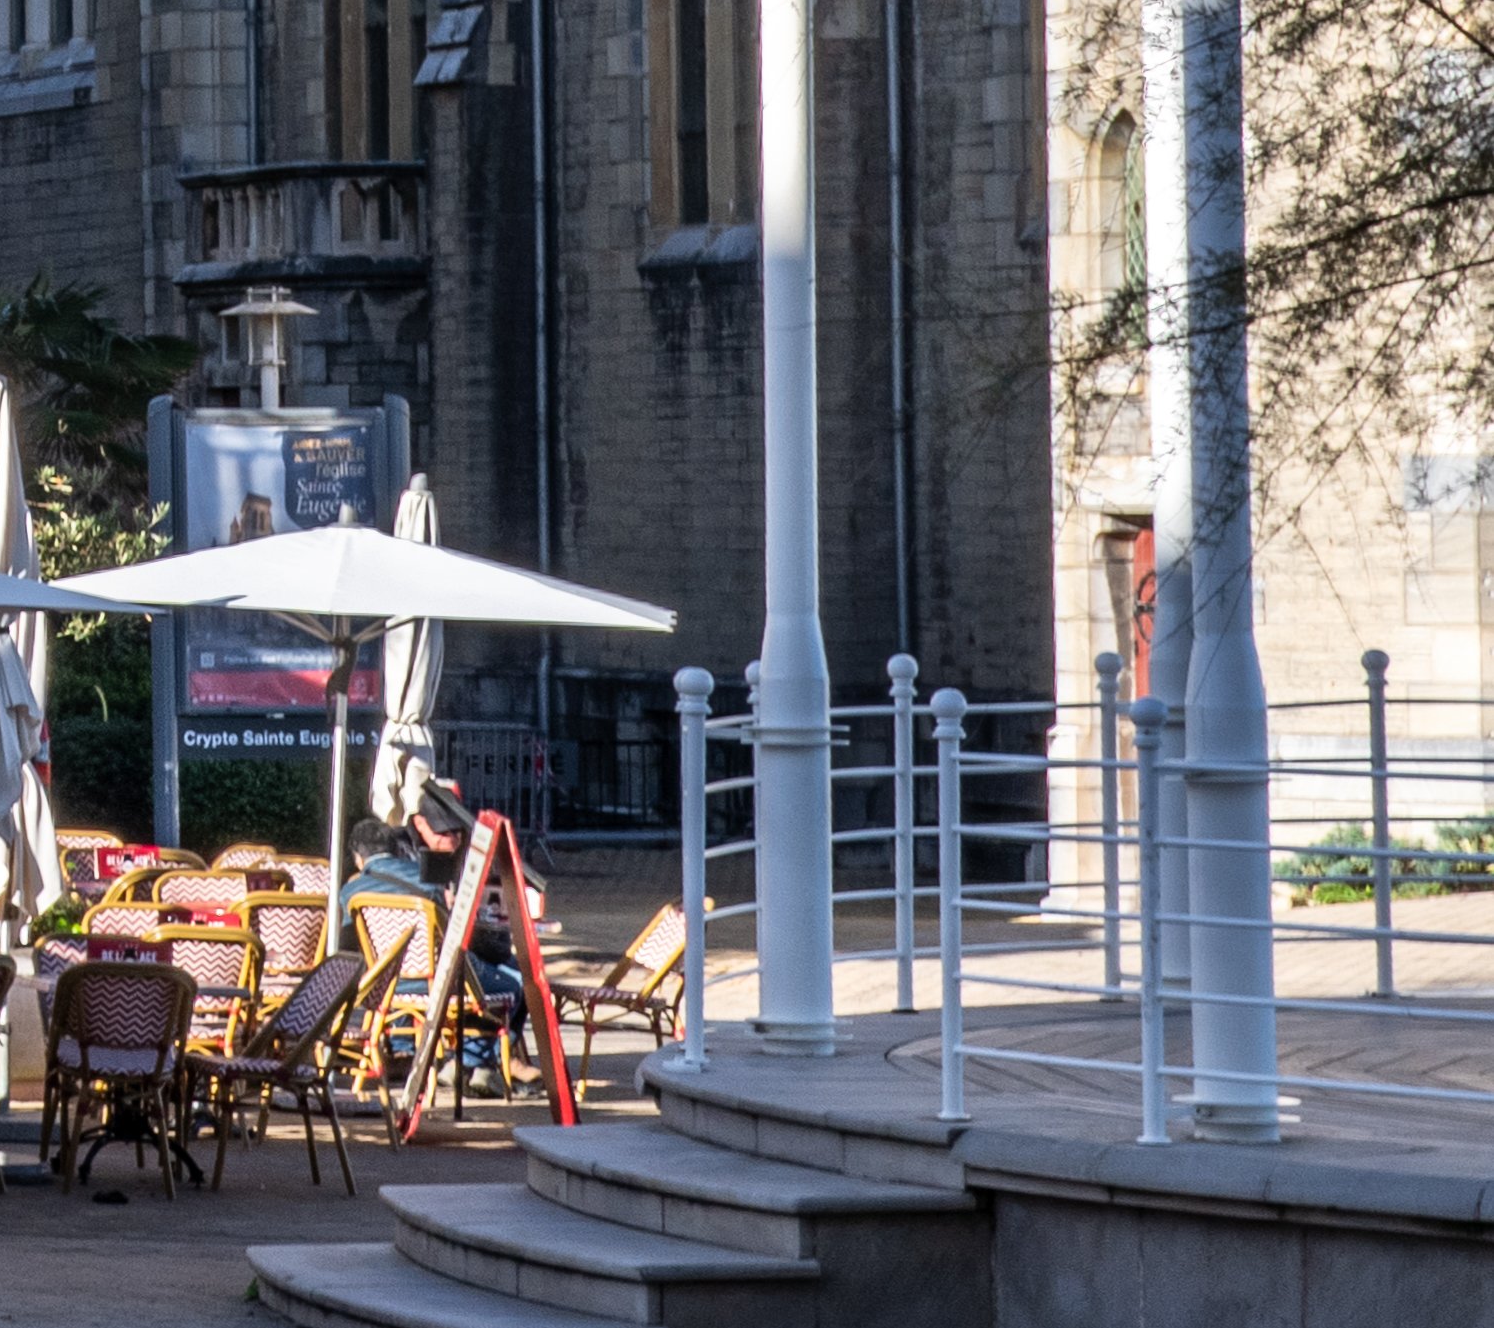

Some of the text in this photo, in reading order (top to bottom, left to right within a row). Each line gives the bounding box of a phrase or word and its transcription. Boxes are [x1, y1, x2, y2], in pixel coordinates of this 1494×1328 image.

[305, 447, 366, 462] SAUVER
[316, 461, 366, 479] l'église
[296, 478, 344, 498] Sainte
[183, 730, 365, 749] Crypte Sainte Eugnie
